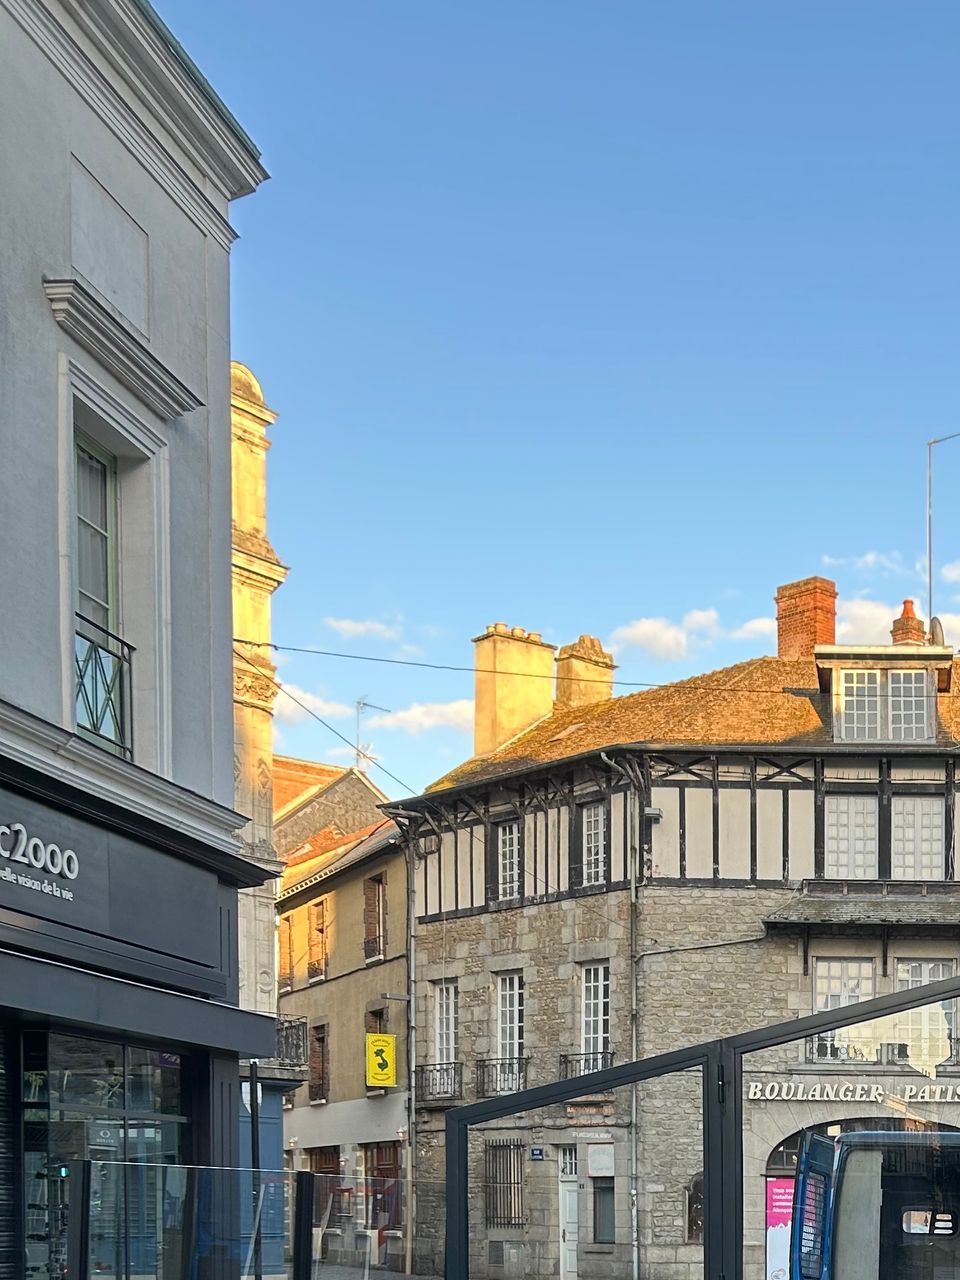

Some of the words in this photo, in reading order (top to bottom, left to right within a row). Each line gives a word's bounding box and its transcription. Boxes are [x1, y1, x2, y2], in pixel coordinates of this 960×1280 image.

[41, 879, 53, 895] de
[52, 882, 61, 898] la
[61, 887, 74, 902] vie
[748, 1082, 883, 1104] BOULANGER
